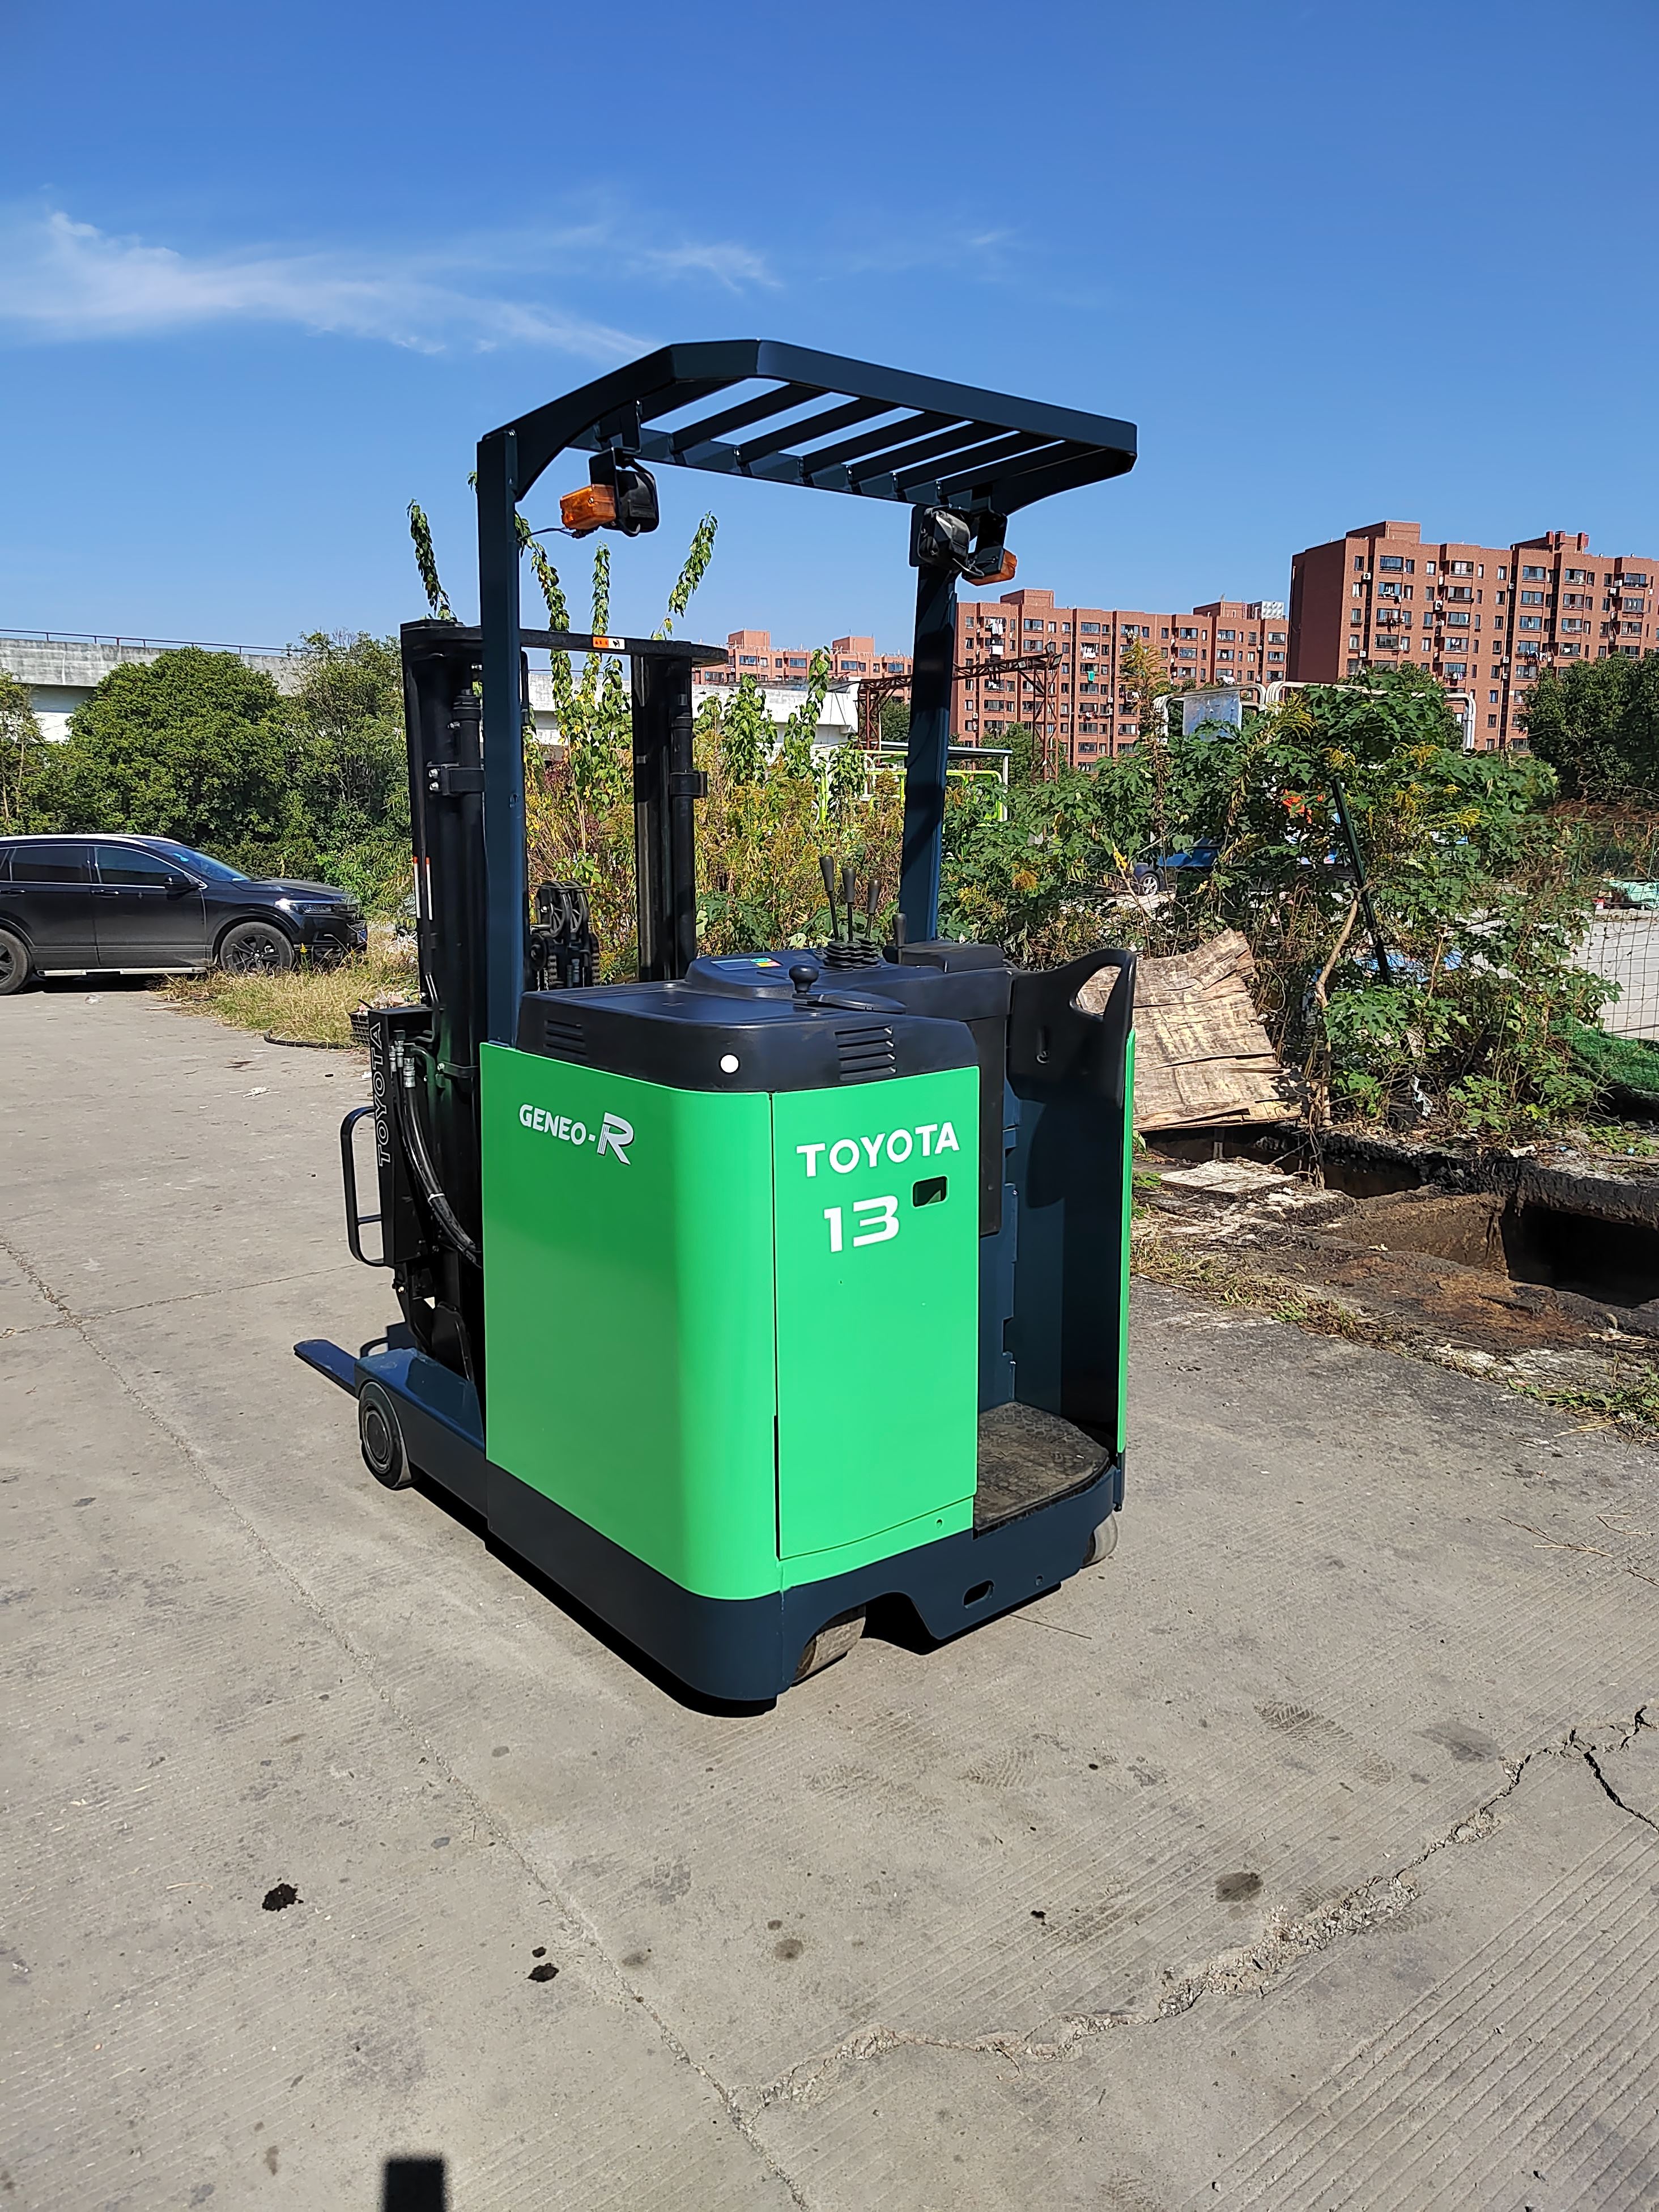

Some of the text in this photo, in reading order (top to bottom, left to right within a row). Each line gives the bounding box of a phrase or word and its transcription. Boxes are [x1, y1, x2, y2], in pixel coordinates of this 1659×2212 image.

[370, 1022, 391, 1167] TOYOTA
[519, 1104, 635, 1165] GENEO-R
[796, 1122, 960, 1177] TOYOTA
[823, 1195, 900, 1253] 13
